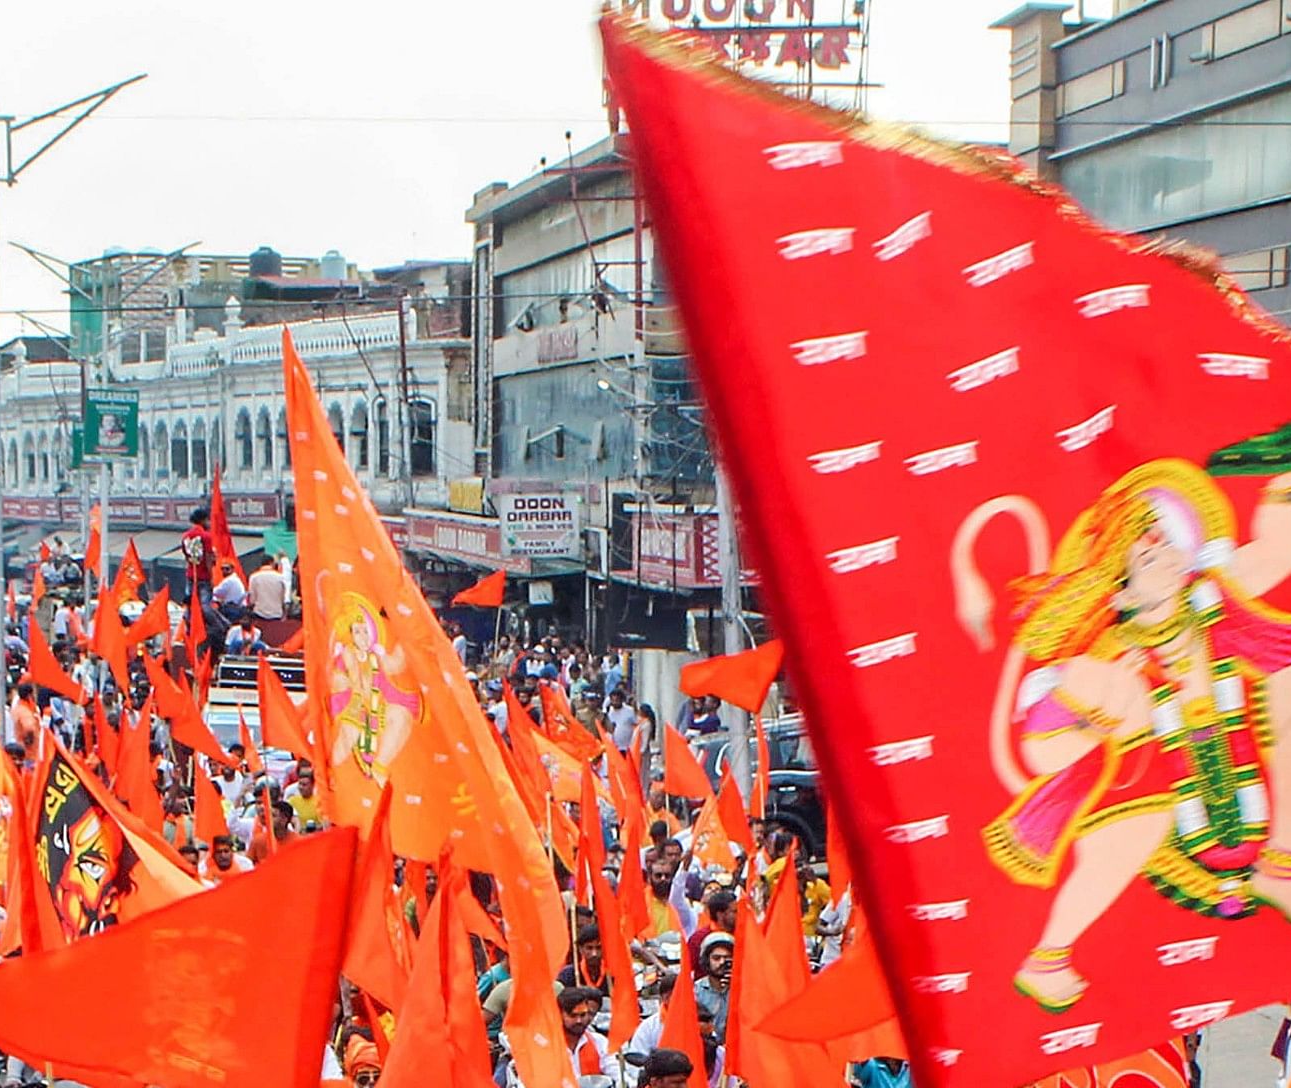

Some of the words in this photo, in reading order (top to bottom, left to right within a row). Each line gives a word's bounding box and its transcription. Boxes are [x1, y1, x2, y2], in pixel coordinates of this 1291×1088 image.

[507, 511, 572, 522] DARBAR
[514, 498, 565, 510] DOON
[511, 548, 570, 556] RESTAURANT
[847, 633, 917, 667] राम
[867, 735, 935, 766] राम
[1157, 937, 1219, 966] राम
[1041, 1023, 1102, 1055] राम
